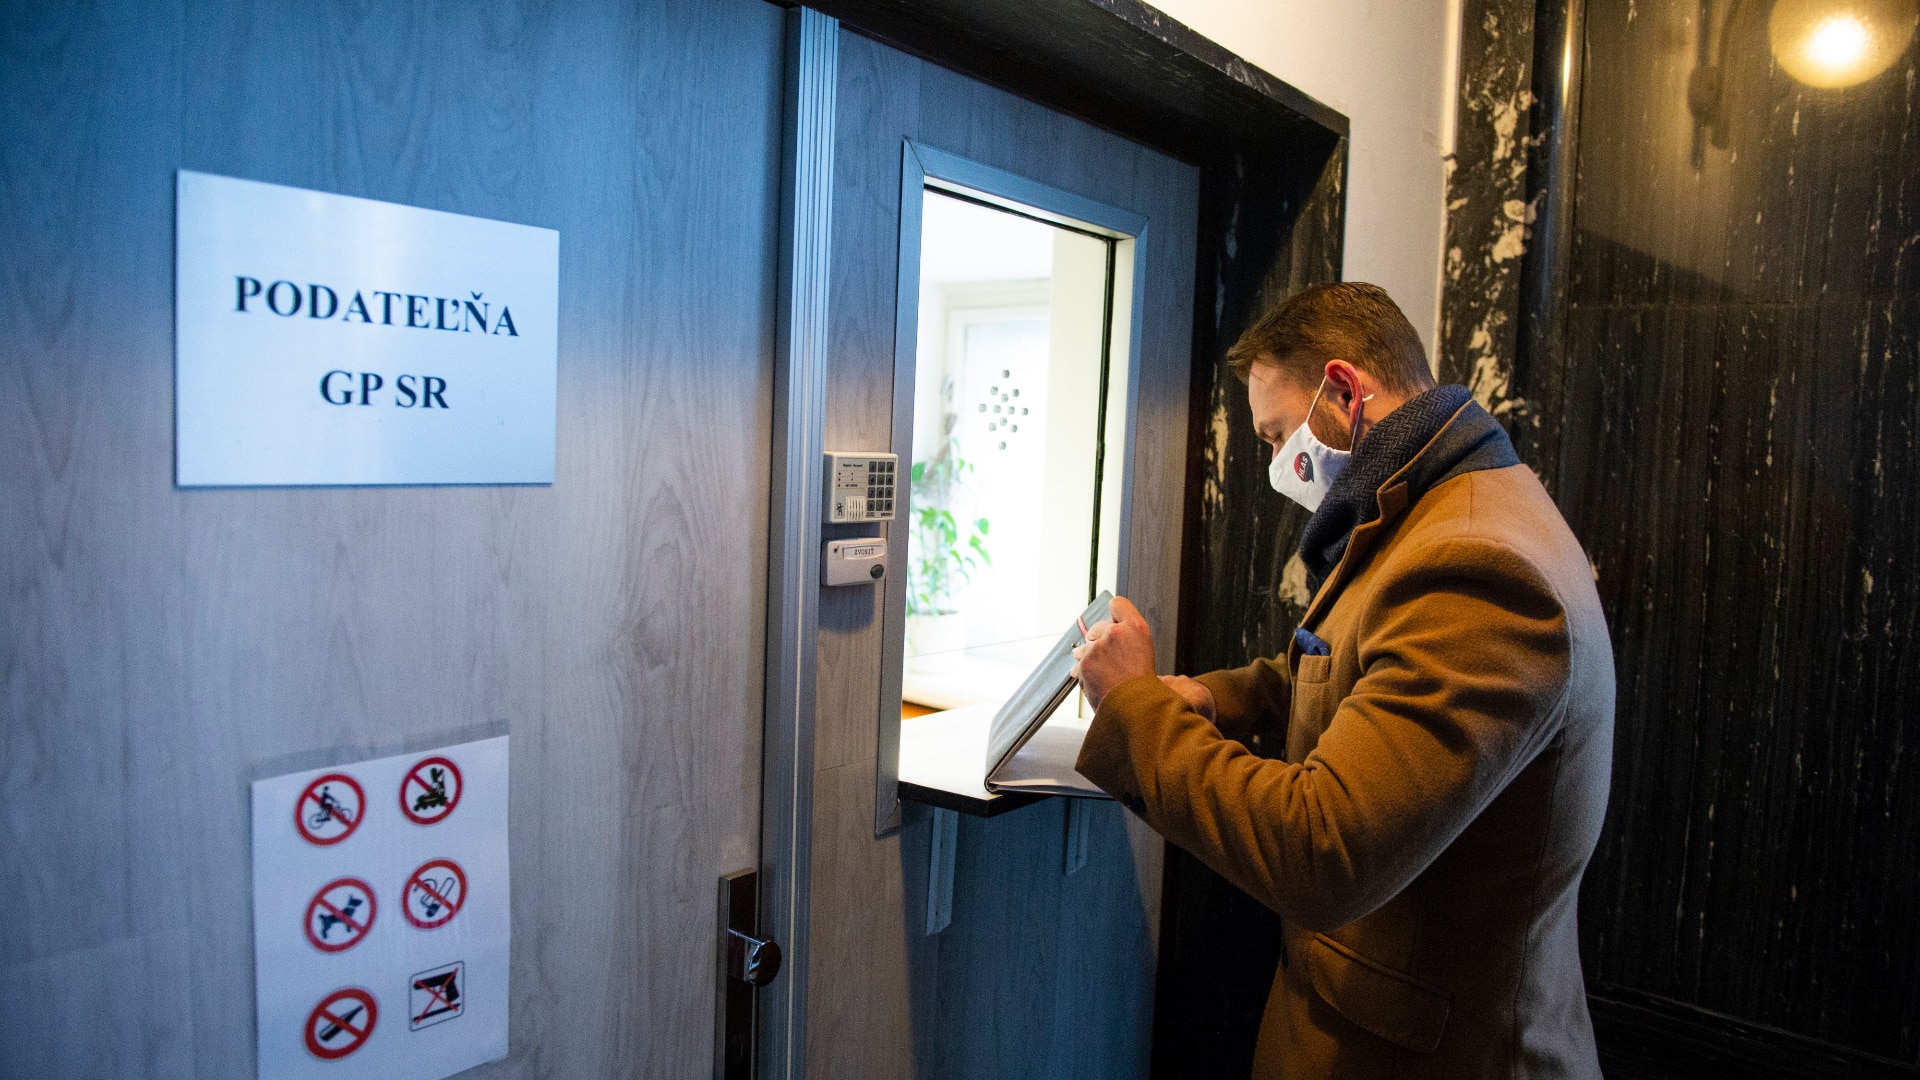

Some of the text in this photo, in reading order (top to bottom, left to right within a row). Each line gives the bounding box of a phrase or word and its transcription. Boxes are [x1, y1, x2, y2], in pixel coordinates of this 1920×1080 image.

[234, 275, 519, 337] PODATEĽŇA
[319, 370, 450, 409] GP SR
[1298, 455, 1309, 479] HLAS
